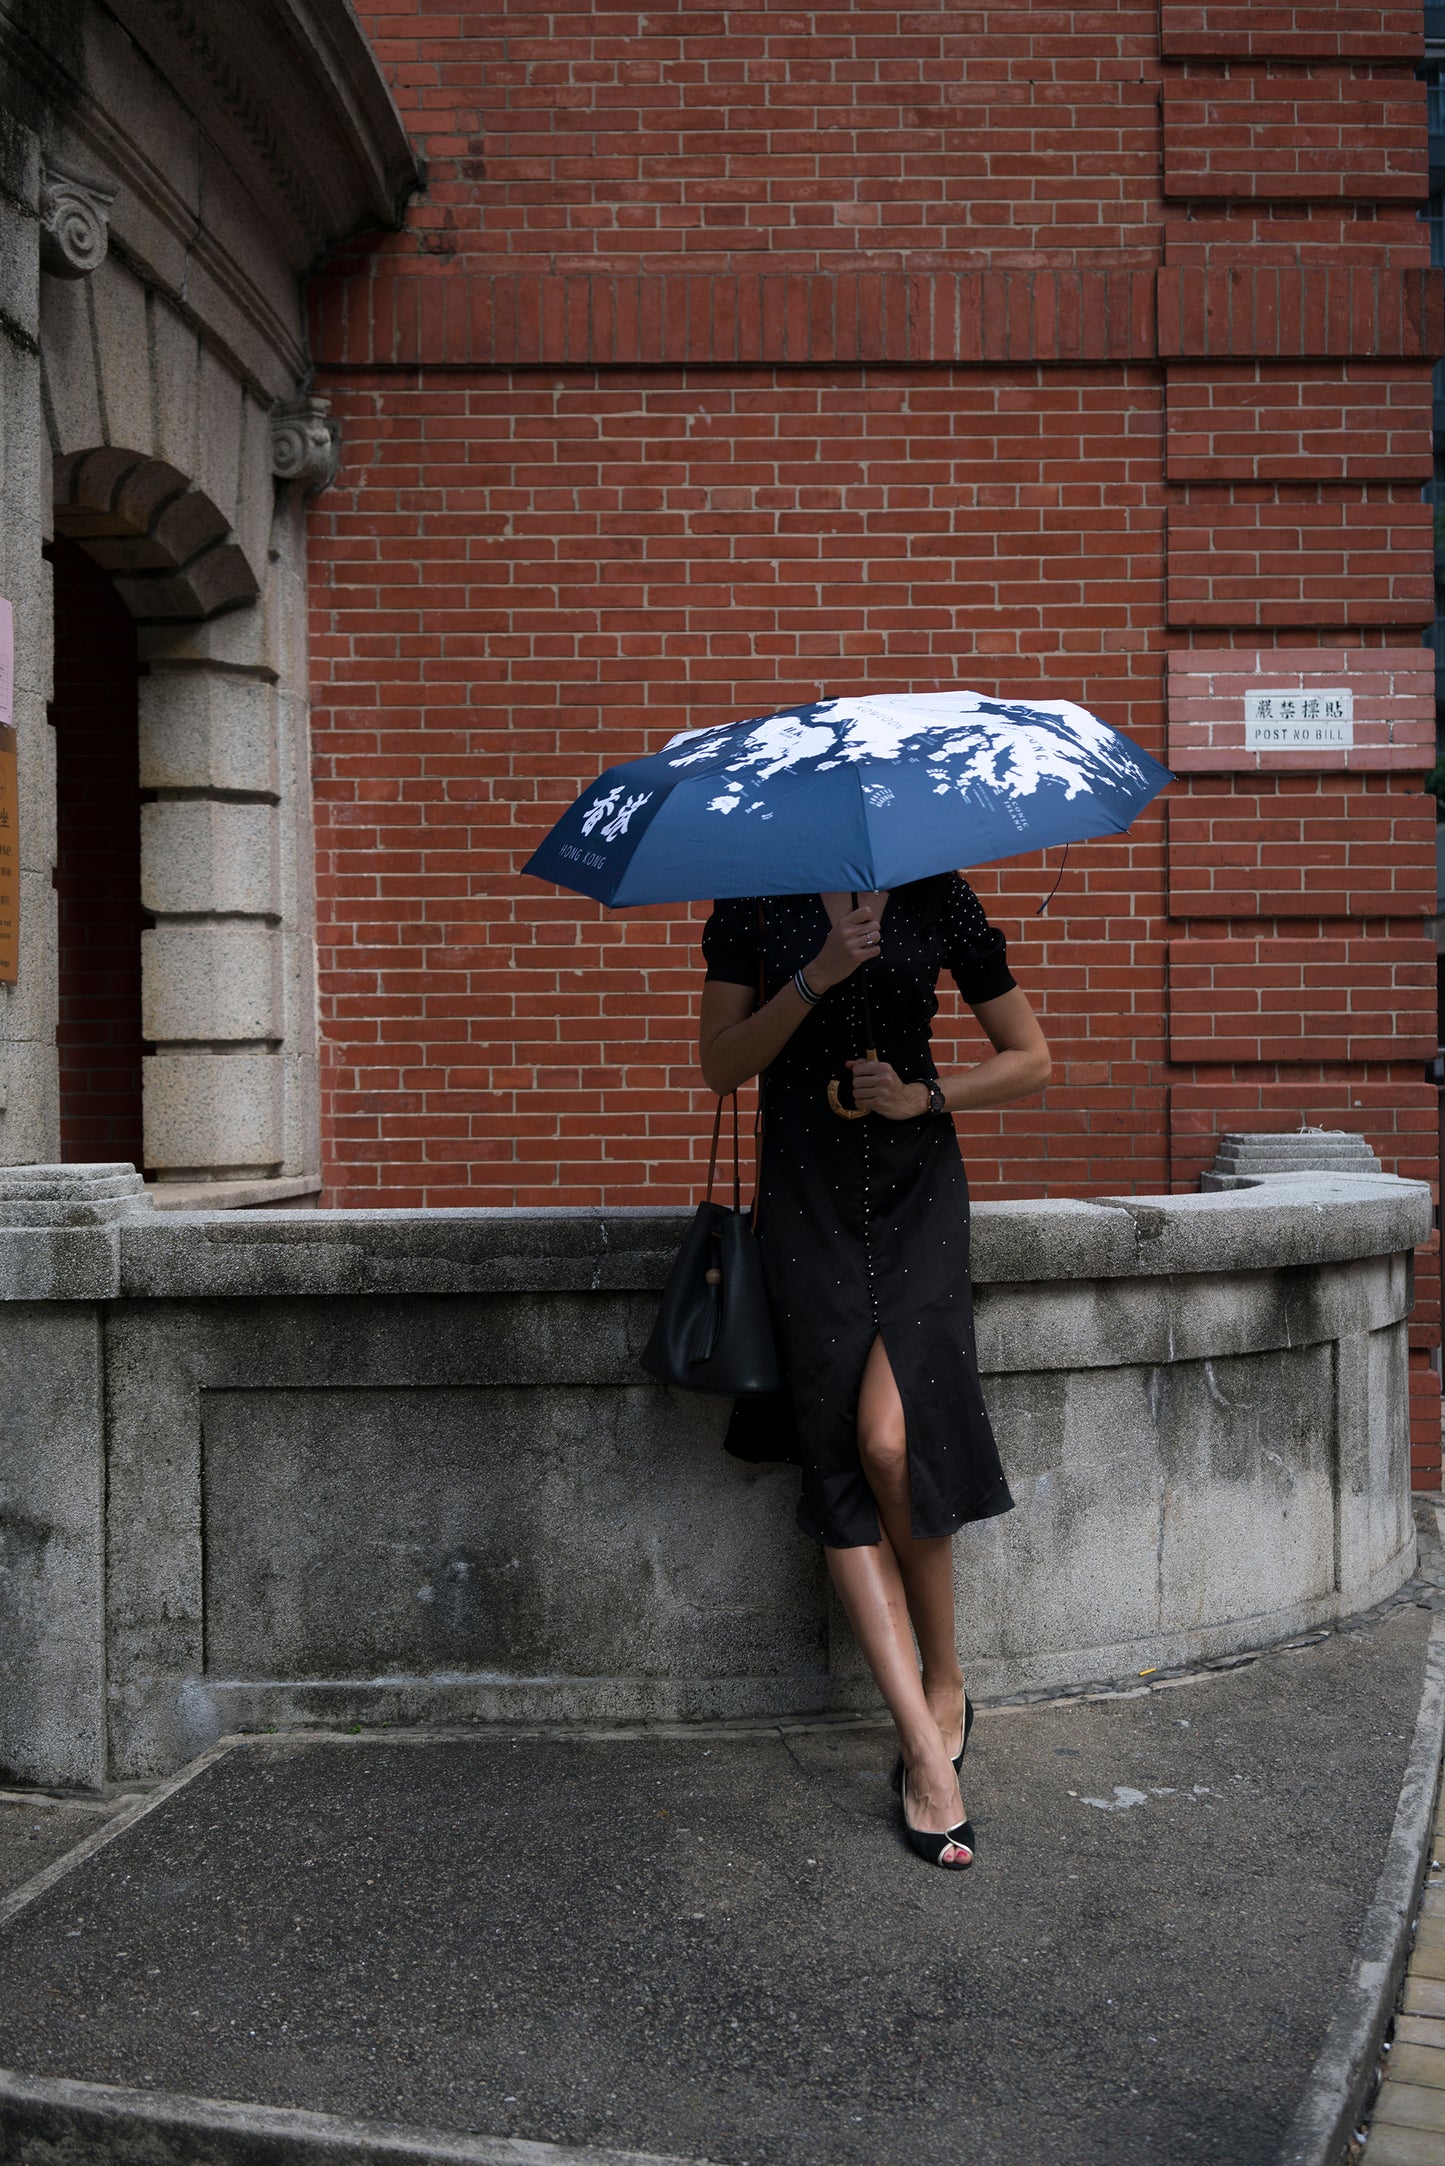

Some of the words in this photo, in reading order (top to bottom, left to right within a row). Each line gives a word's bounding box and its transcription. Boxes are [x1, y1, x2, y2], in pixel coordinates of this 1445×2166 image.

[1255, 699, 1343, 719] 嚴禁標貼
[1255, 729, 1288, 740] POST
[1293, 729, 1310, 740] NO
[1315, 729, 1344, 740] BILL
[580, 785, 654, 843] 香港
[558, 843, 583, 862] HONG
[582, 851, 607, 870] KONG
